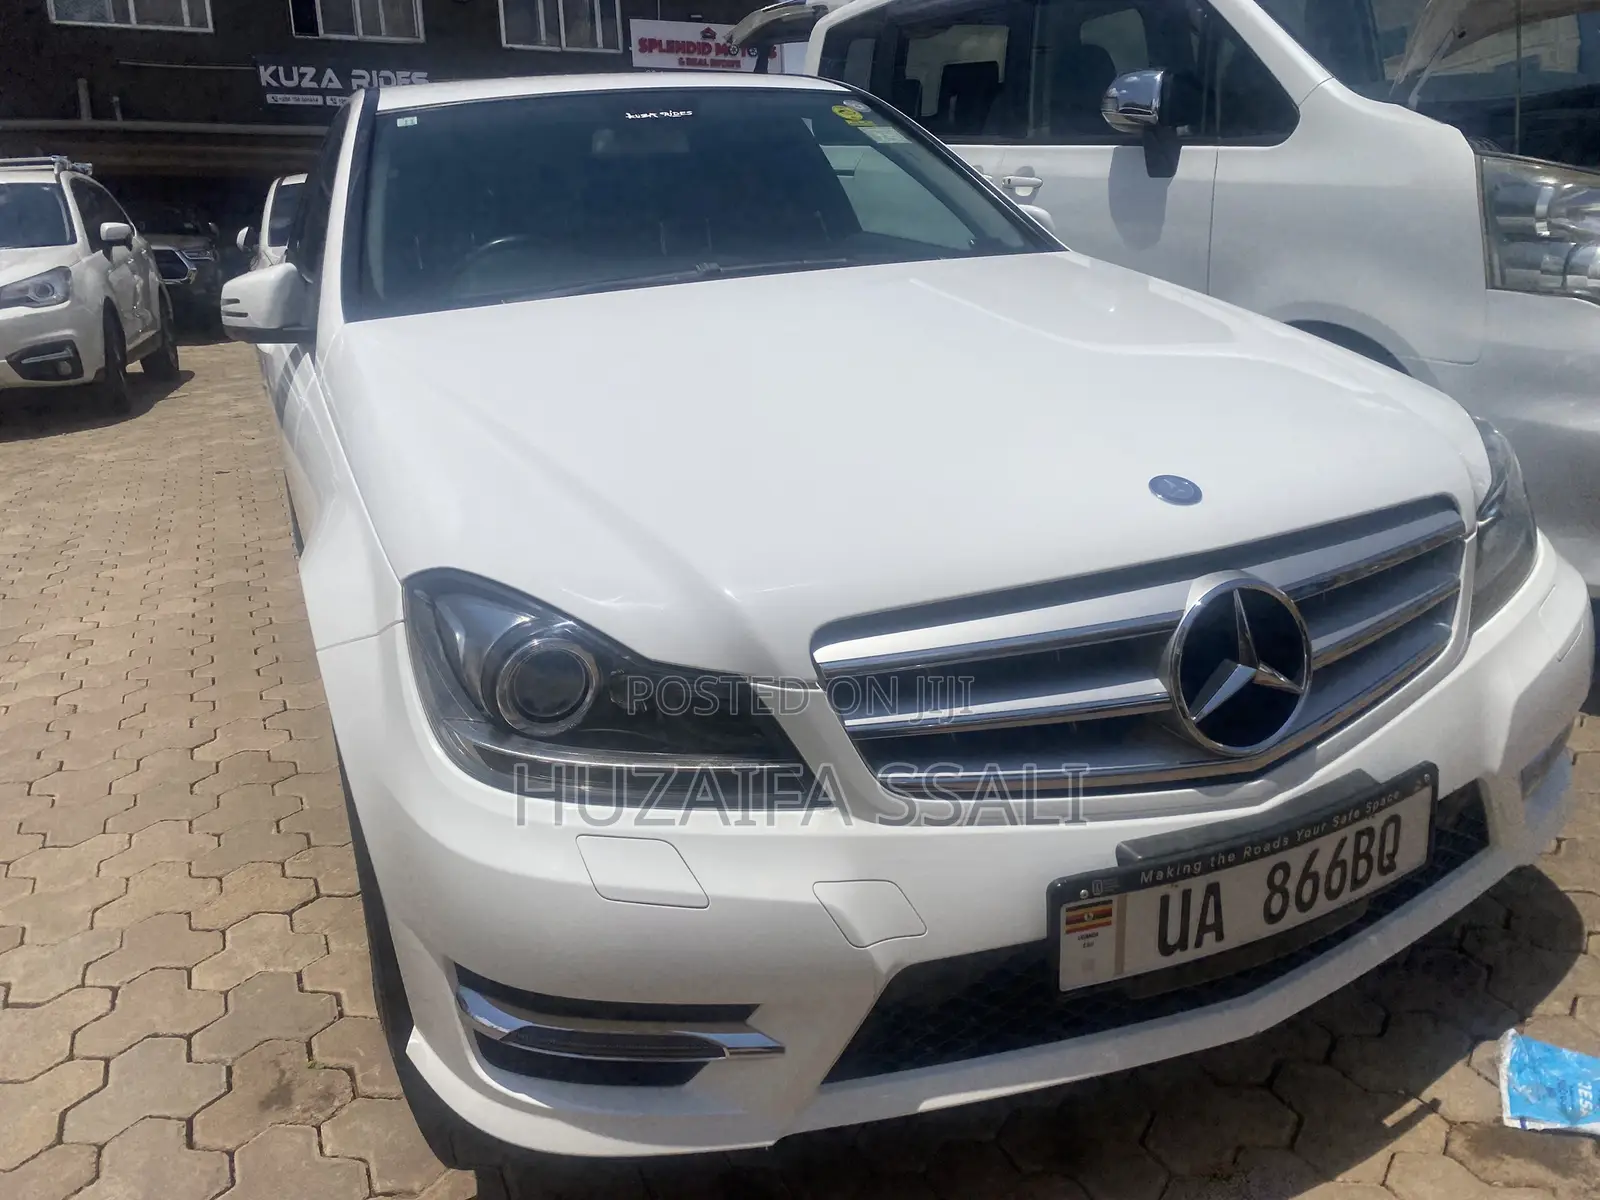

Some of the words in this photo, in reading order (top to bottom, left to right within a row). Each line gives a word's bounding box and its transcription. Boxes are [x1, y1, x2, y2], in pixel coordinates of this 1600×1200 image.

[638, 37, 713, 55] SPLENDID
[715, 42, 777, 58] MOTOS
[259, 65, 344, 89] KUZA
[351, 69, 428, 90] RIDES
[1140, 861, 1202, 884] Making
[1210, 851, 1236, 868] the
[1243, 836, 1289, 860] Roads
[1296, 822, 1327, 842] Your
[1332, 808, 1361, 828] Safe
[1366, 790, 1400, 814] Space
[1157, 881, 1225, 957] UA
[1262, 813, 1402, 925] 866BQ
